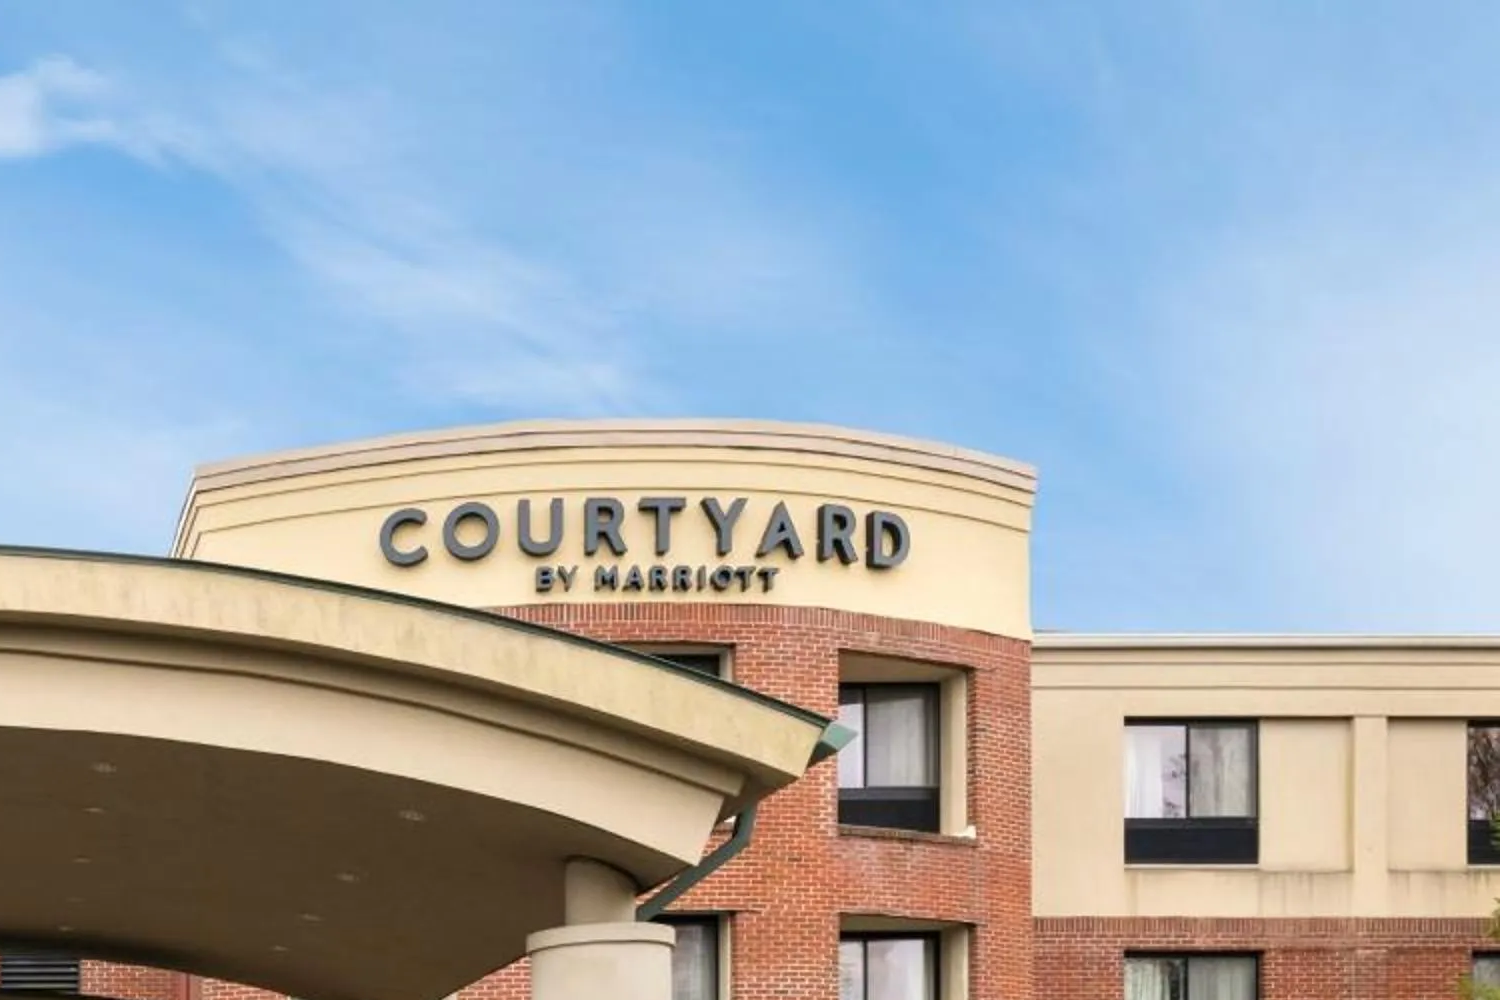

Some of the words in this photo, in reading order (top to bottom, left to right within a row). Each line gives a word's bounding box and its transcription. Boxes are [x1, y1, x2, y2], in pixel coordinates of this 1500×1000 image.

[379, 497, 911, 569] COURTYARD
[535, 565, 579, 593] BY
[594, 565, 780, 594] MARRIOTT
